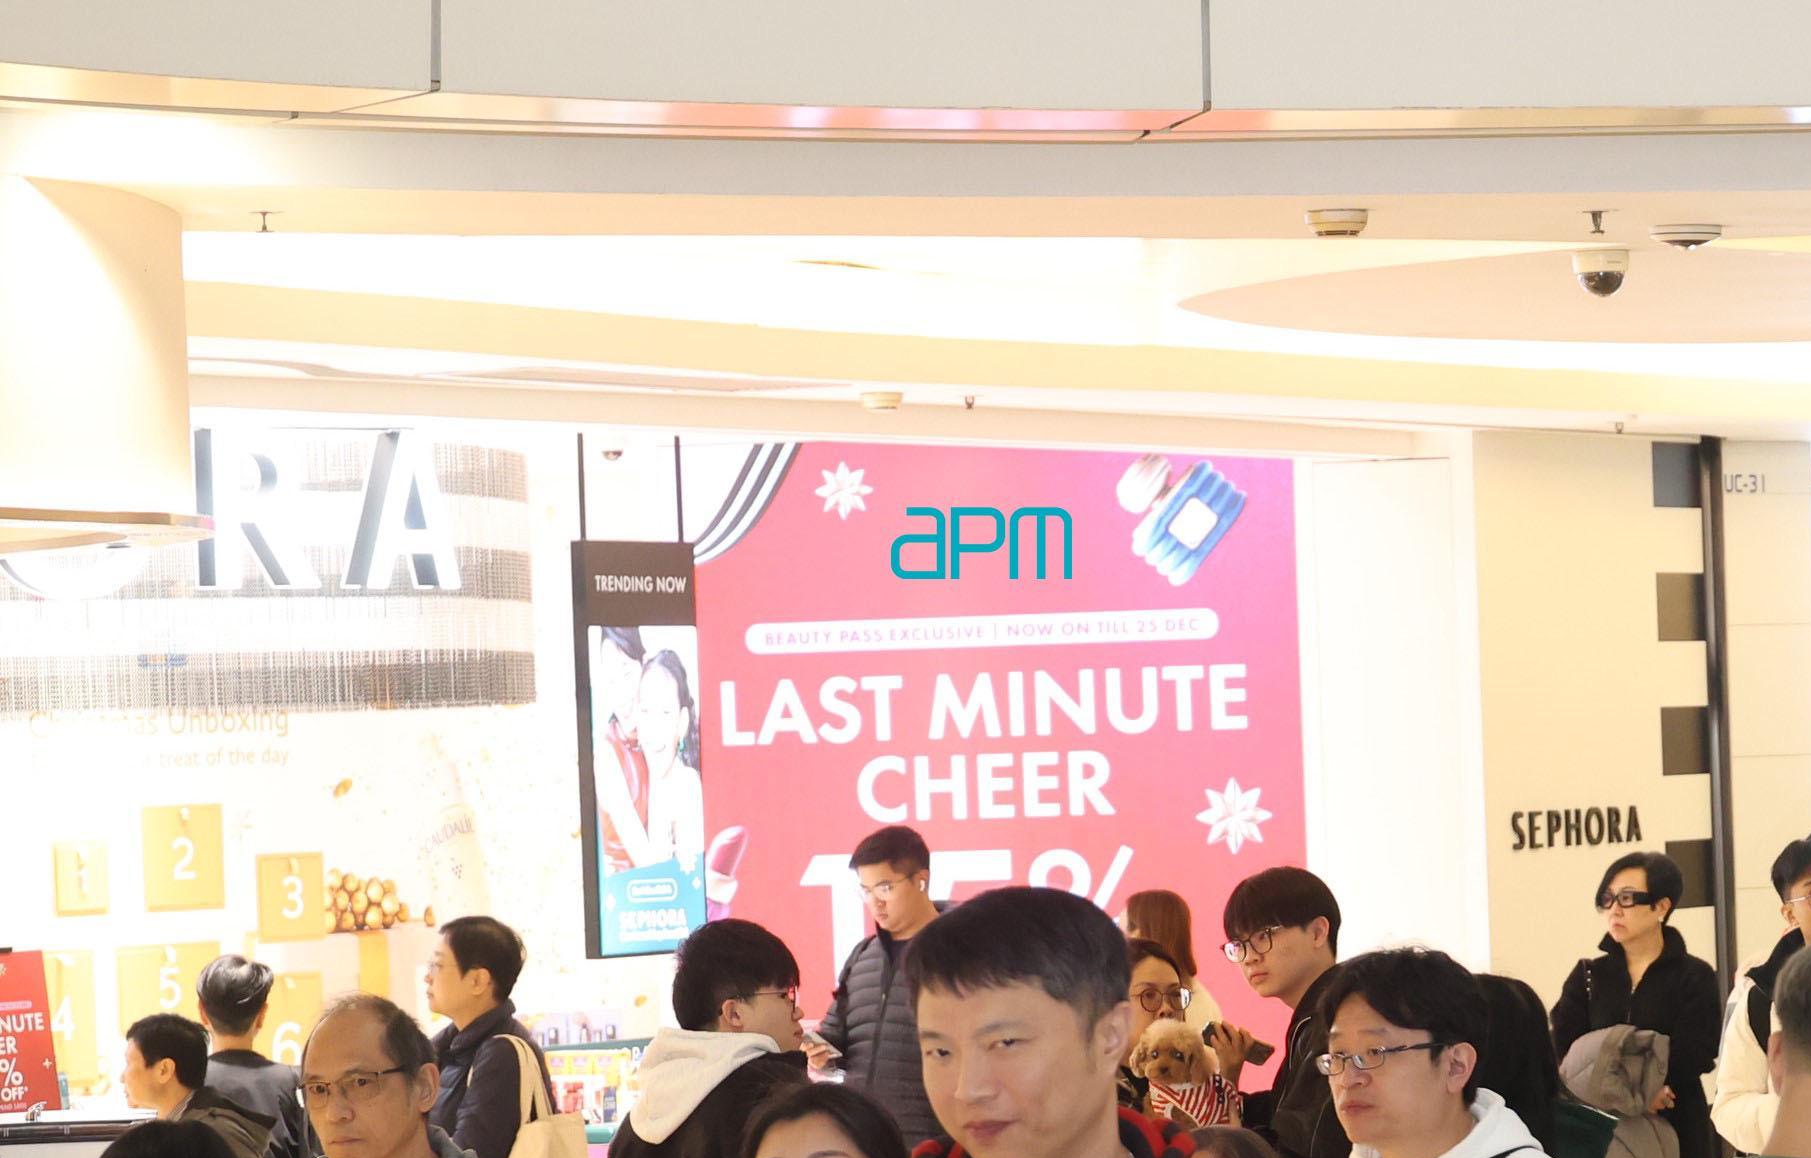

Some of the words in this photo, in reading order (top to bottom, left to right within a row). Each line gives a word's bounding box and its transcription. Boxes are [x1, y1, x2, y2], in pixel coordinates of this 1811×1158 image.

[594, 574, 654, 593] TRENDING
[655, 575, 687, 594] NOW
[764, 629, 832, 647] BEAUTY
[839, 627, 883, 644] PASS
[888, 624, 985, 643] EXCLUSIVE
[1006, 621, 1053, 638] NOW
[1060, 620, 1090, 636] ON
[1096, 619, 1128, 635] TILL
[1135, 618, 1159, 633] 25
[1164, 617, 1200, 632] DEC
[719, 674, 903, 747] LAST
[927, 663, 1249, 741] MINUTE
[856, 750, 1116, 822] CHEER
[1511, 805, 1643, 850] SEPHORA
[172, 837, 196, 880] 2
[281, 875, 305, 919] 3
[160, 967, 181, 1009] 5
[51, 996, 75, 1041] 4
